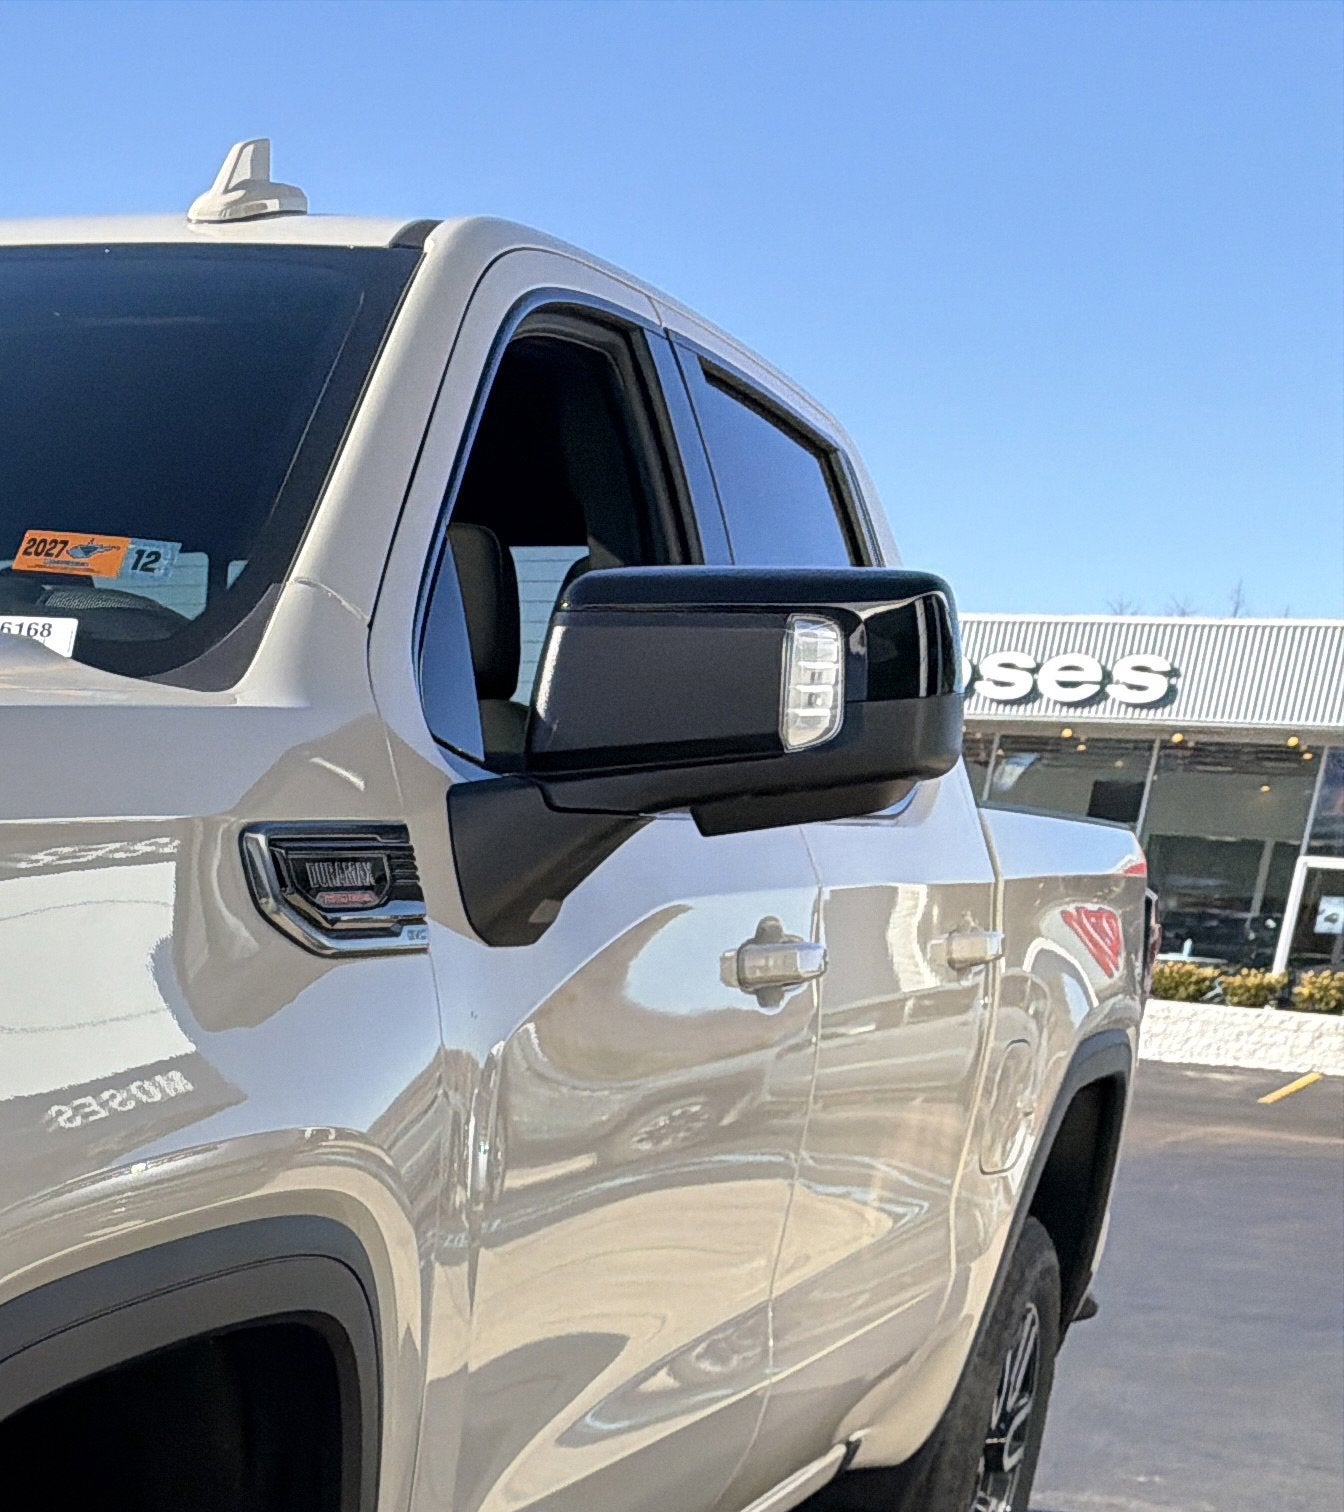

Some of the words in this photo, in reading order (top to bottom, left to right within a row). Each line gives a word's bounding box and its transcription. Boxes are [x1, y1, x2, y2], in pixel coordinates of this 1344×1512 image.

[22, 537, 70, 558] 2027
[130, 548, 163, 574] 12
[961, 650, 1179, 705] ses
